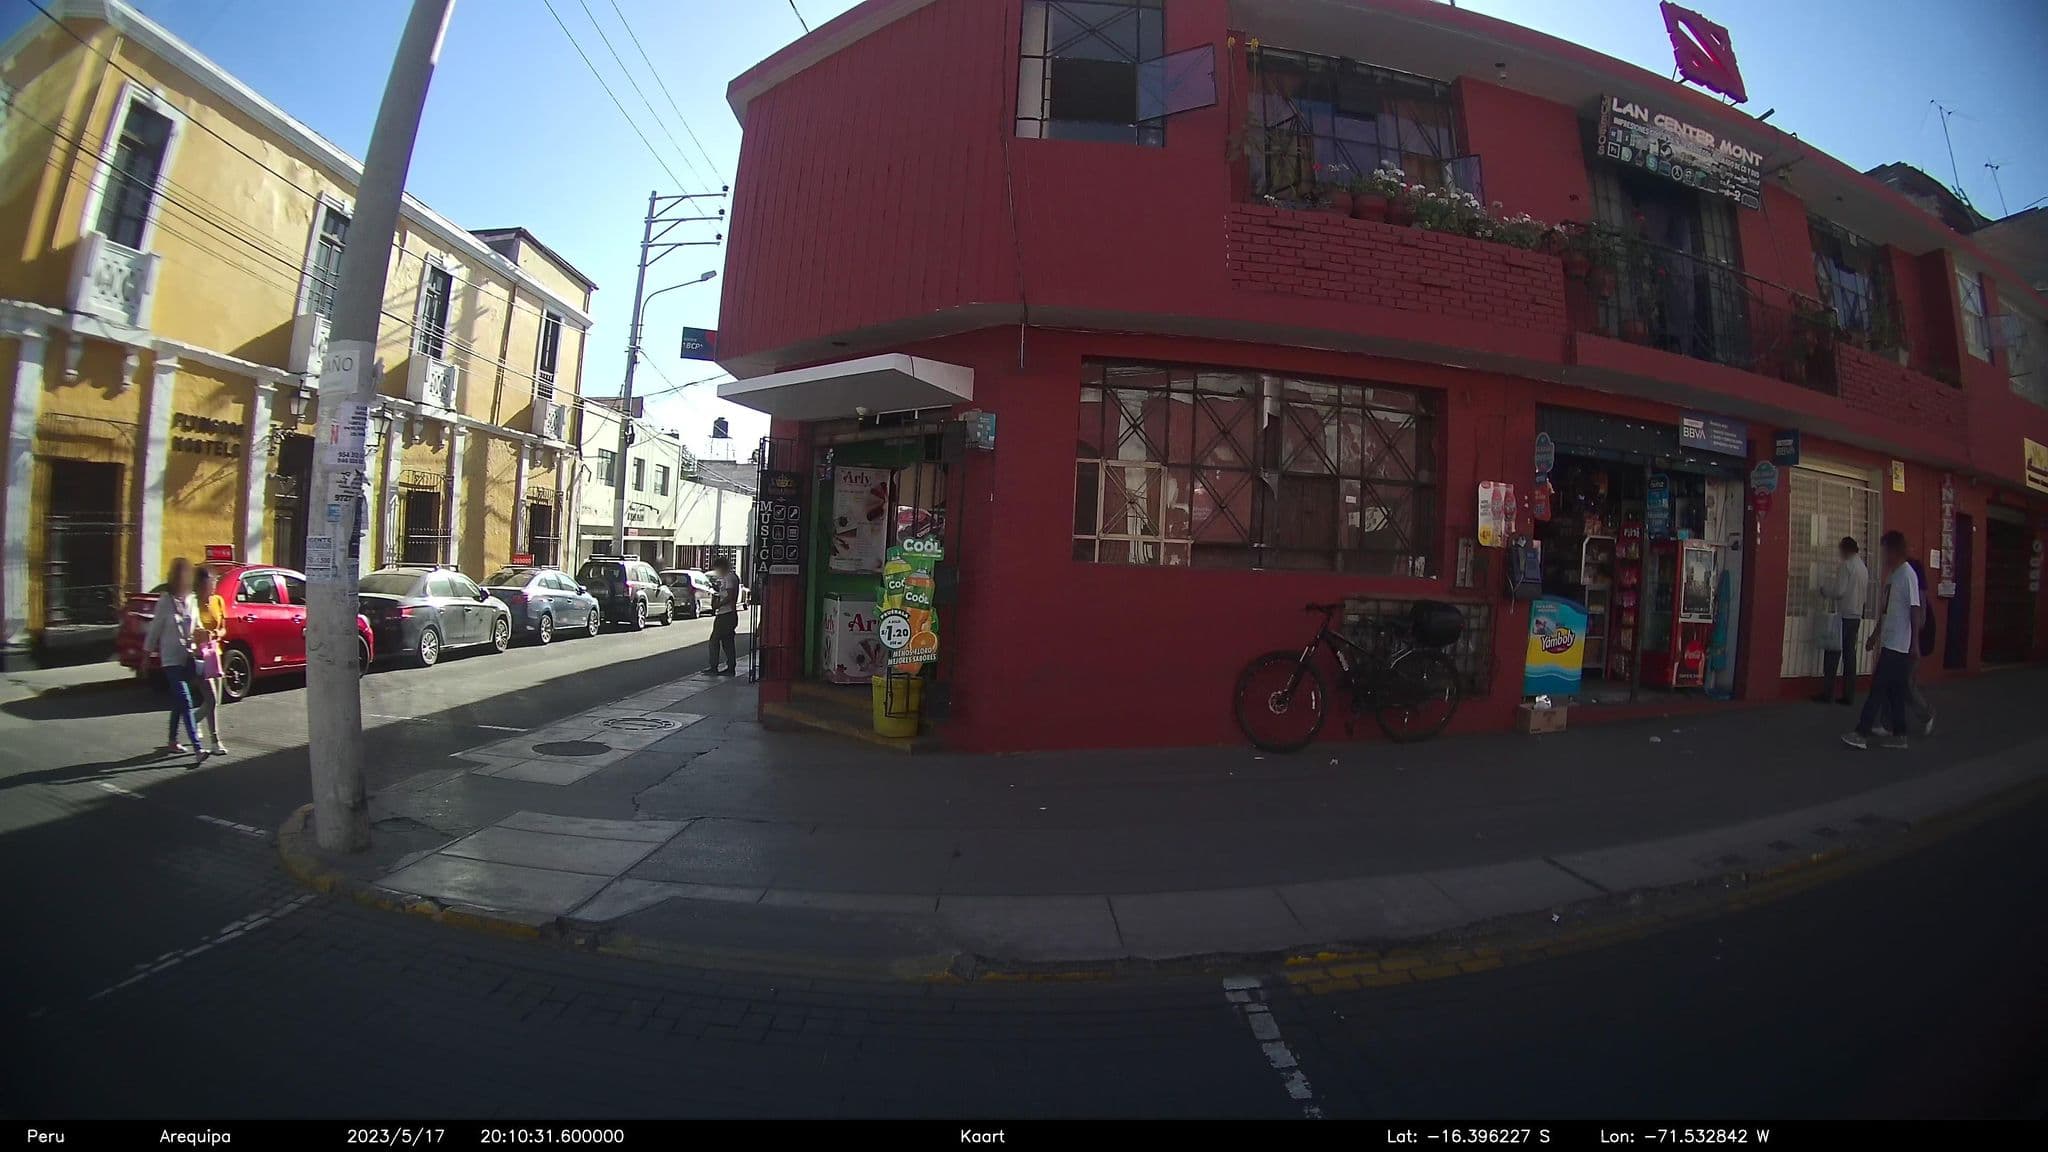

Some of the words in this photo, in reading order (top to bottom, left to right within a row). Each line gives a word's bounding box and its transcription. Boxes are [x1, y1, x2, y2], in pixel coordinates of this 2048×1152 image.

[1612, 98, 1649, 123] LAN
[1654, 114, 1715, 148] CENTER
[1719, 139, 1763, 167] MONT
[1683, 427, 1706, 440] BBVA
[1942, 473, 1954, 584] INTERNE
